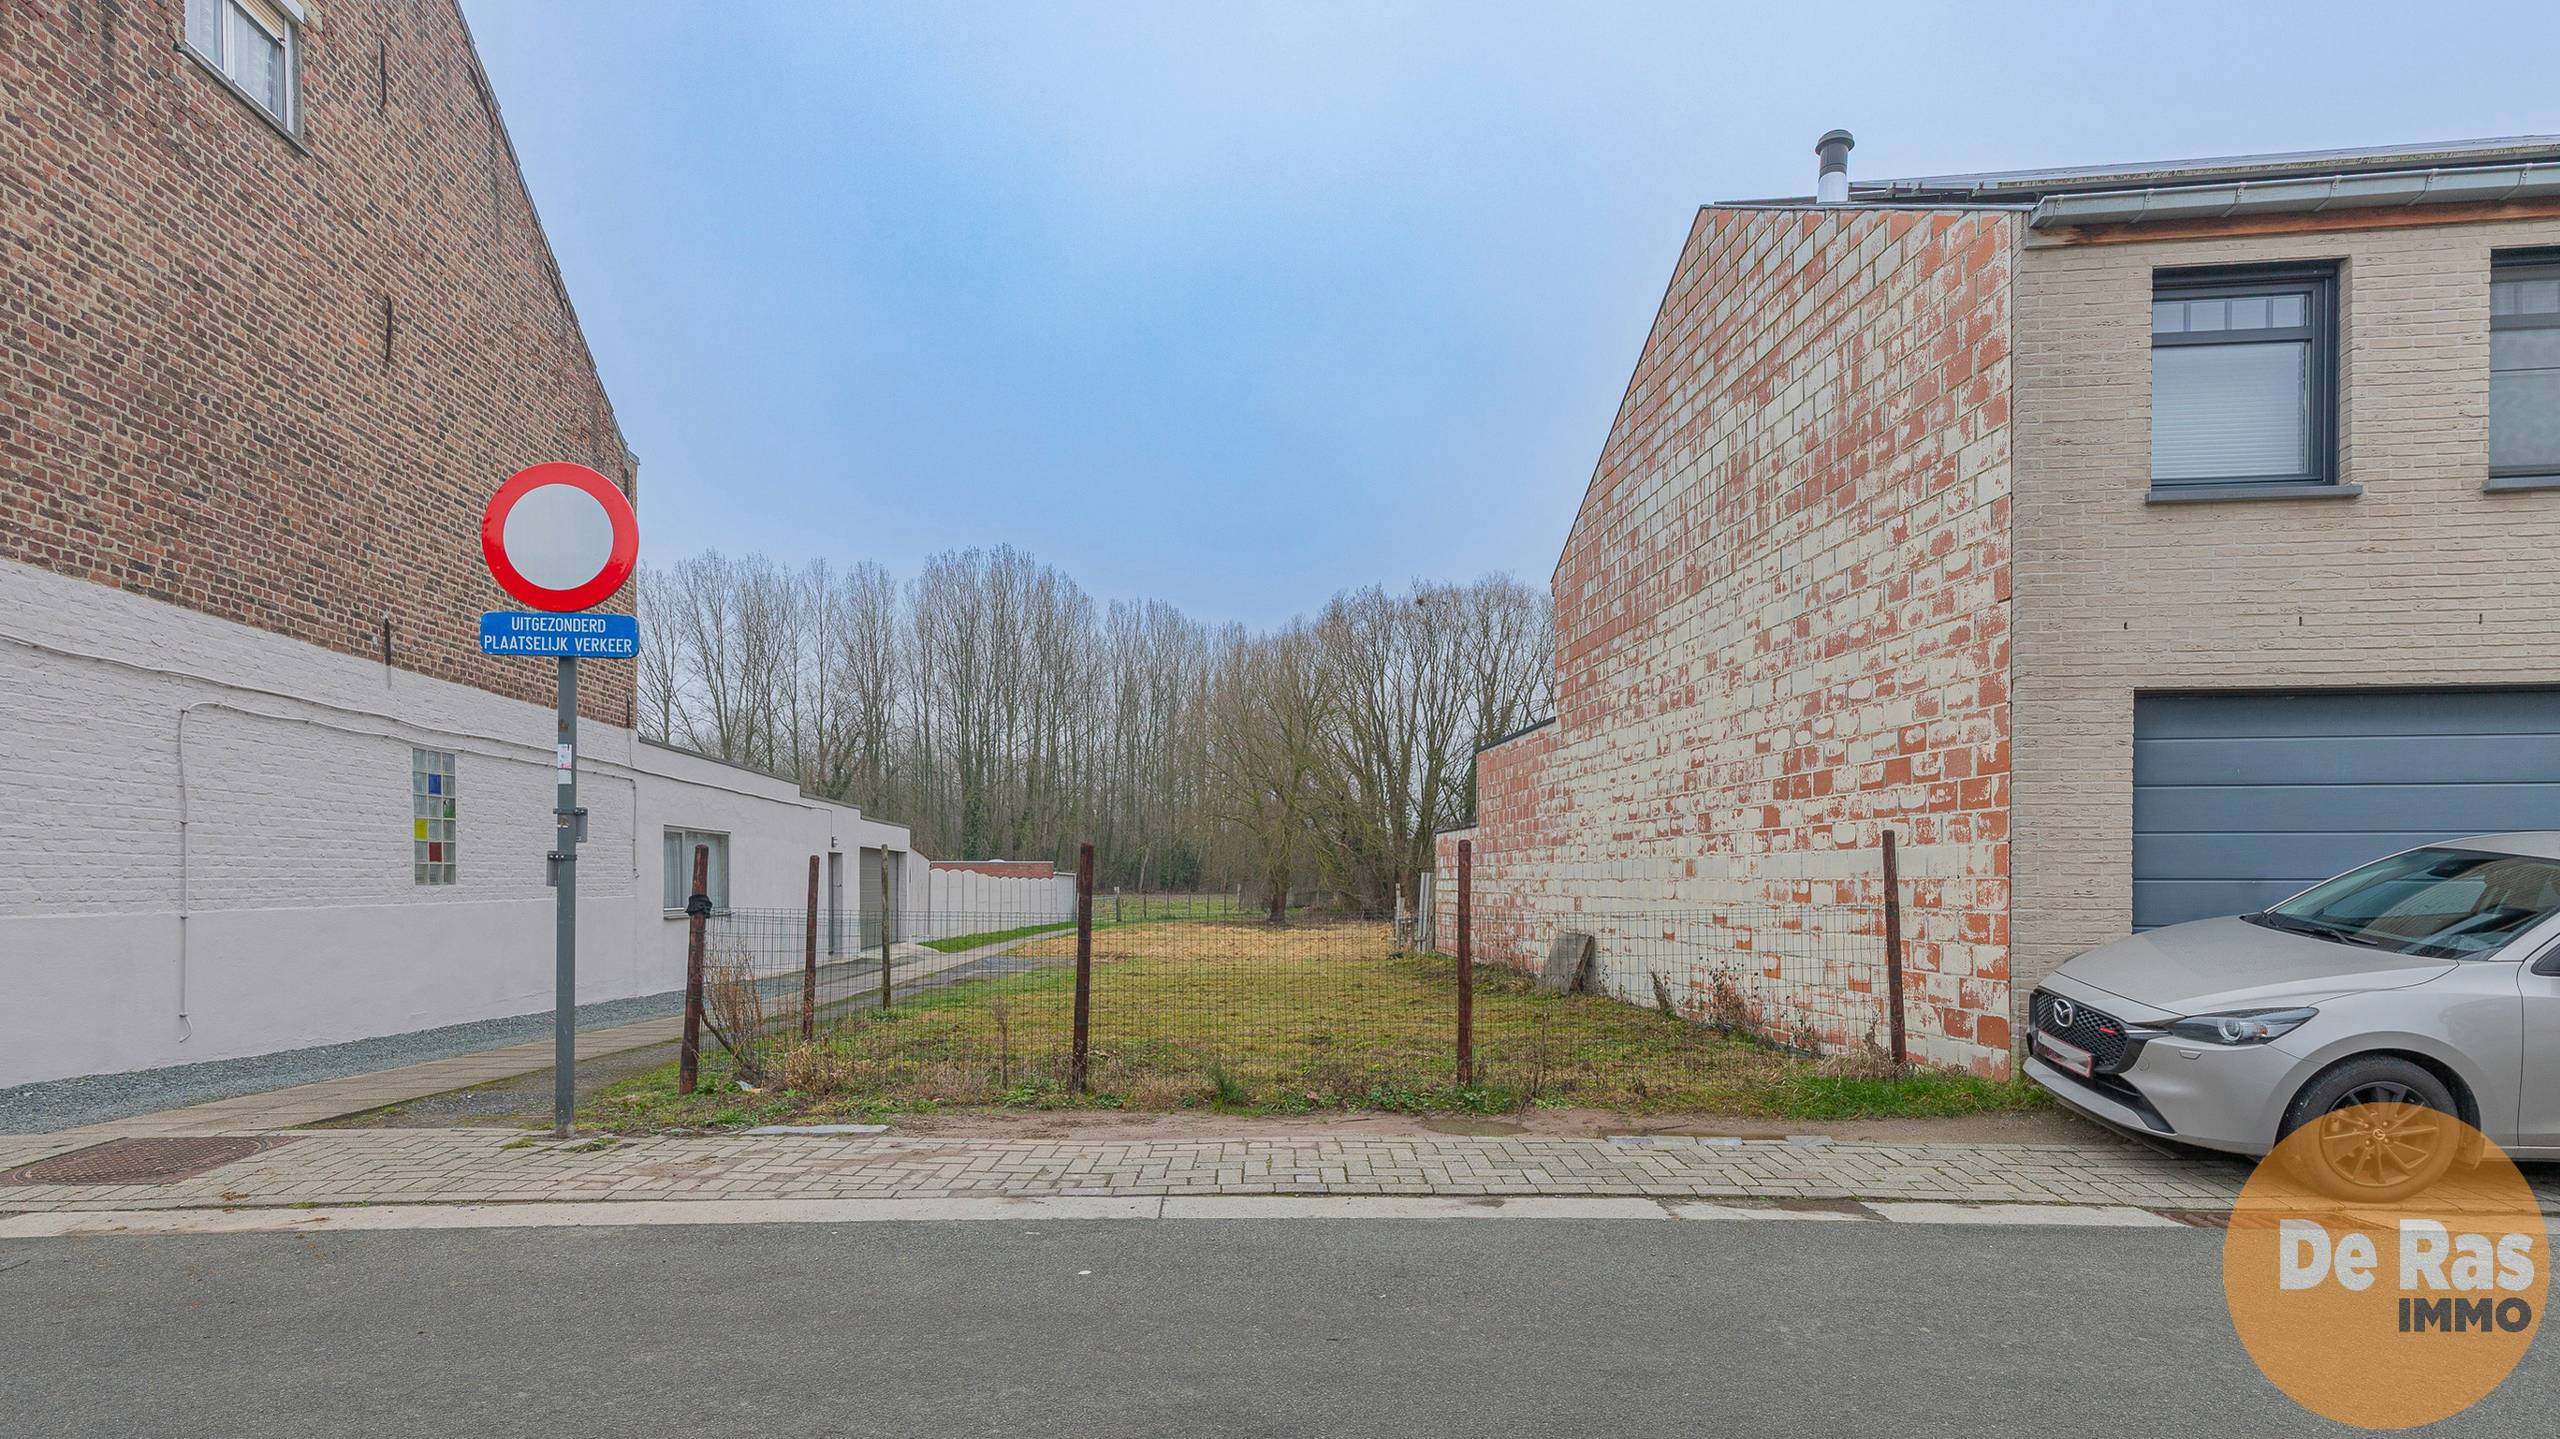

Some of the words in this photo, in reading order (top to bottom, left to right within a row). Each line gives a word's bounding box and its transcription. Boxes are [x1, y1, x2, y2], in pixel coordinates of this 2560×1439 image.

[511, 616, 606, 633] UITGEZONDERD
[484, 635, 568, 651] PLAATSELIJK
[574, 637, 632, 653] VERKEER
